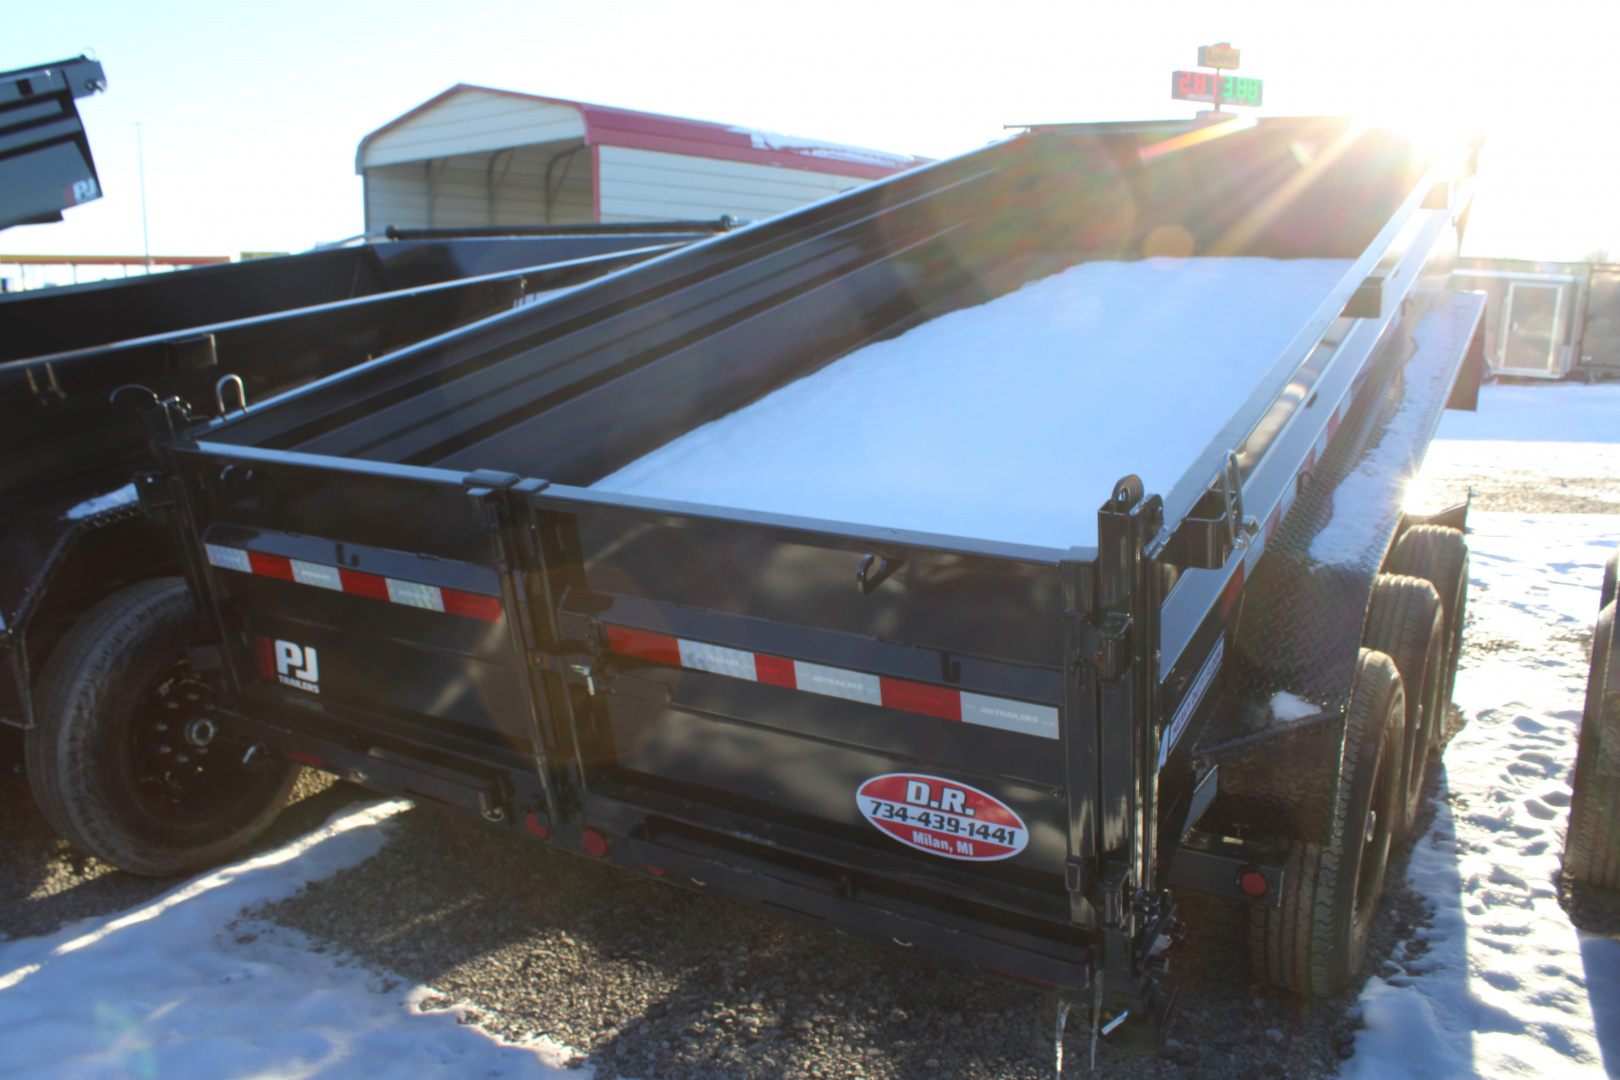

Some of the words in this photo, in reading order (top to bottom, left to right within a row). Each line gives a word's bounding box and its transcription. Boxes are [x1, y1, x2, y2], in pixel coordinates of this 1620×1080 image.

[72, 177, 97, 201] PJ
[275, 639, 319, 683] PJ
[278, 674, 321, 694] TRAILERS
[905, 779, 977, 817] D.R.
[870, 800, 1016, 846] 734-439-1441
[912, 830, 953, 854] Milan,
[956, 840, 974, 856] MI
